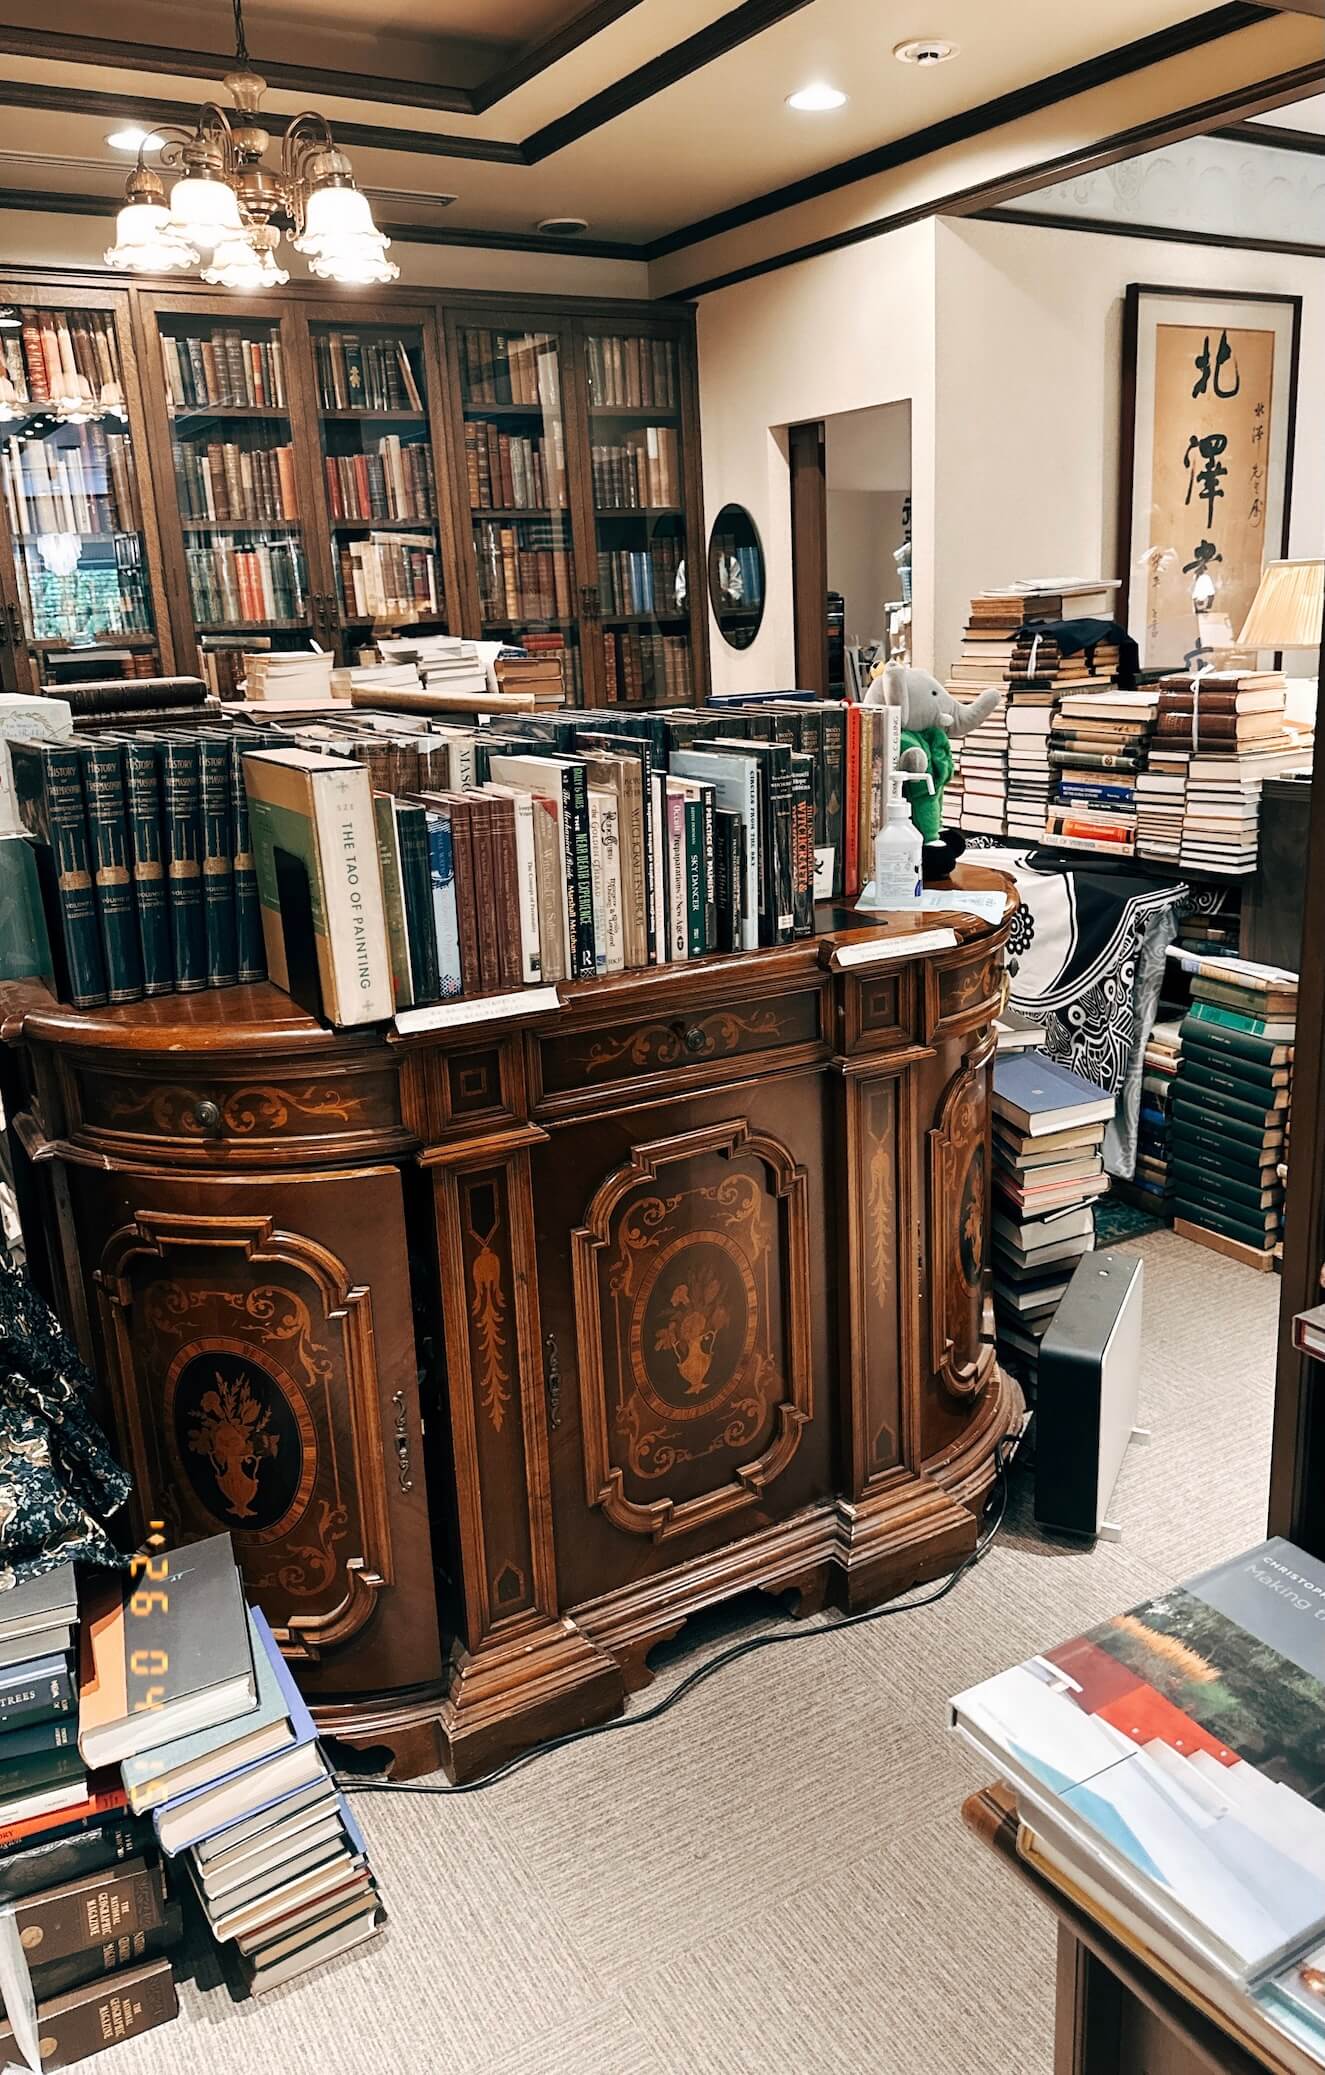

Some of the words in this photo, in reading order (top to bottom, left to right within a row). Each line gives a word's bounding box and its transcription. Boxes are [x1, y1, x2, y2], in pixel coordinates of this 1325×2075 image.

[47, 764, 76, 777] HISTORY
[88, 761, 116, 773] HISTORY
[673, 805, 681, 831] Occult
[342, 822, 355, 849] THE
[575, 833, 588, 854] NEAR
[797, 800, 808, 881] WITCHCRAFT
[691, 855, 699, 871] SKY
[706, 846, 713, 857] OF
[346, 857, 359, 885] TAO
[577, 855, 590, 879] DEATH
[350, 892, 362, 911] OF
[568, 885, 576, 917] Marshall
[691, 875, 699, 911] DANCER
[798, 882, 808, 894] &
[578, 881, 592, 925] EXPERIENCE
[353, 917, 371, 990] PAINTING
[582, 950, 592, 965] R
[1244, 1564, 1312, 1610] Making
[0, 1690, 36, 1707] TREES
[86, 1899, 100, 1936] MAGAZINE
[98, 1892, 112, 1935] GEOGRAPHIC
[110, 1895, 121, 1925] NATIONAL
[121, 1901, 130, 1914] THE
[109, 1997, 126, 2036] GEOGRAPHIC
[122, 1998, 134, 2026] NATIONAL
[132, 2002, 142, 2014] THE
[98, 2005, 114, 2039] MAGAZINE
